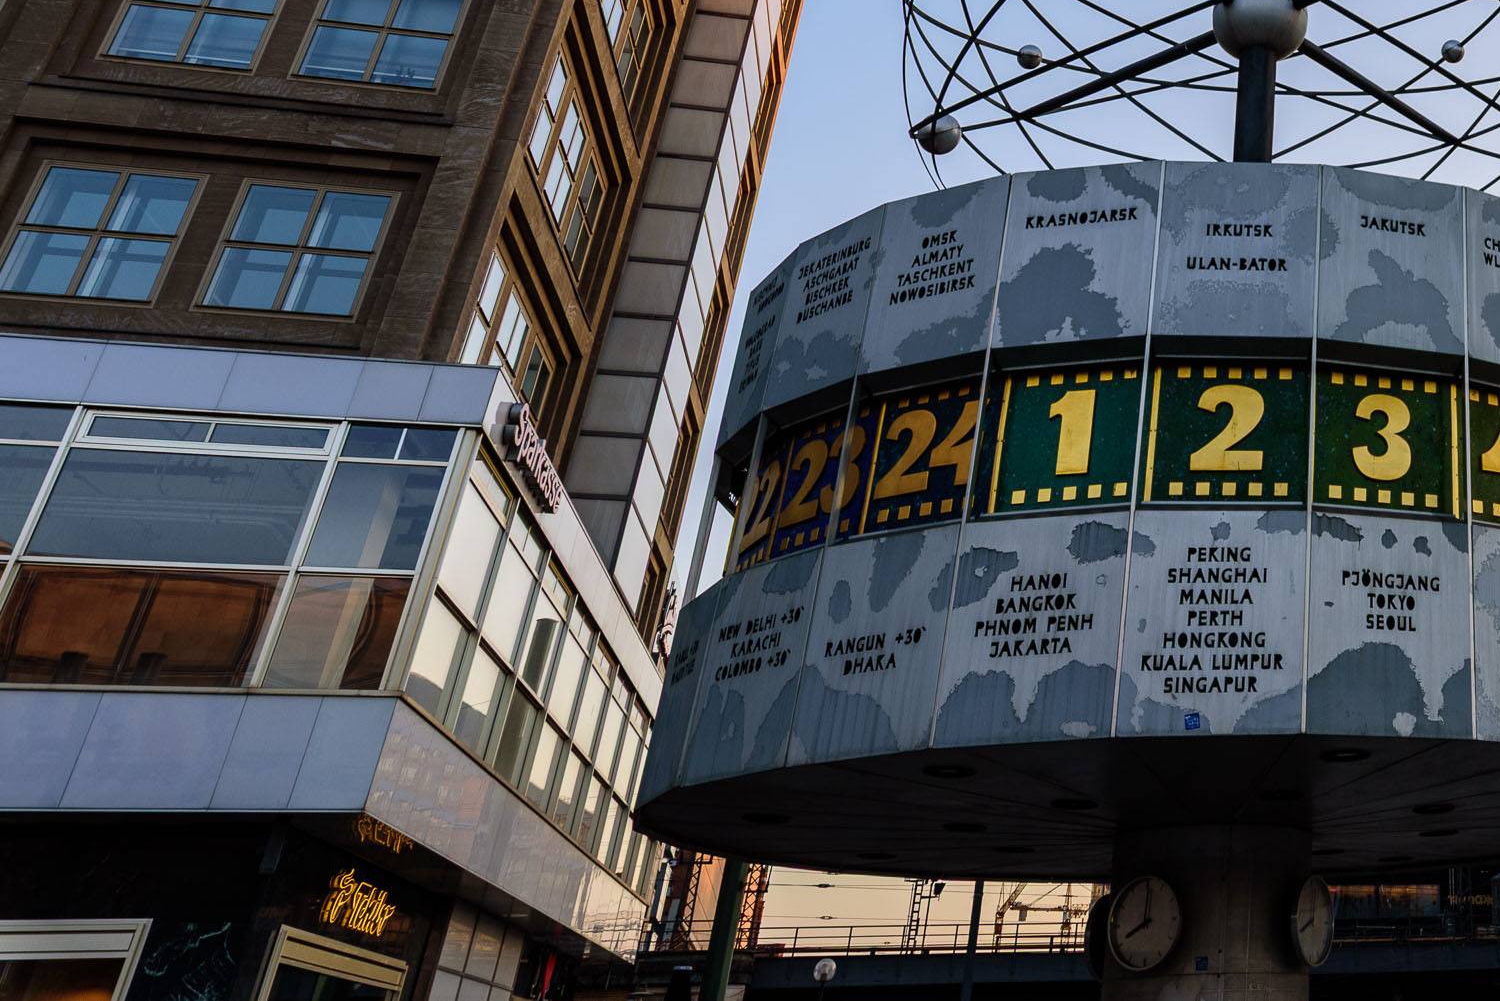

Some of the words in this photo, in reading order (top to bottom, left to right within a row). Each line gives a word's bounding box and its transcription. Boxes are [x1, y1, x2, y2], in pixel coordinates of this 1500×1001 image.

[1025, 206, 1138, 230] KRASNOJARSK
[1360, 215, 1426, 237] JAKUTSK
[921, 229, 958, 249] OMSK
[1205, 223, 1274, 238] IRKUTSK
[798, 237, 872, 280] JEKATERINBURG
[911, 244, 965, 268] ALMATY
[1186, 256, 1288, 272] ULAN-BATOR
[803, 257, 860, 292] ASCHGABAT
[897, 258, 975, 287] TASCHKENT
[804, 276, 850, 306] BISCHKEK
[889, 274, 976, 306] NOWOSIBIRSK
[796, 290, 854, 325] DUSCHANBE
[1048, 388, 1097, 476] 1
[1188, 384, 1265, 472] 2
[1351, 393, 1412, 481] 3
[514, 402, 565, 515] Sparkasse
[873, 398, 981, 500] 24
[778, 423, 867, 529] 23
[1186, 546, 1251, 563] PEKING
[1009, 572, 1068, 592] HANOI
[1167, 567, 1268, 584] SHANGHAI
[1341, 568, 1440, 593] PJÖNGJANG
[994, 593, 1077, 615] BANGKOK
[1178, 588, 1254, 605] MANILA
[1367, 593, 1416, 612] TOKYO
[718, 621, 743, 643] NEW
[745, 613, 777, 635] DELHI
[974, 616, 1039, 638] PHNOM
[1046, 613, 1094, 633] PENH
[1186, 610, 1244, 627] PERTH
[1365, 613, 1417, 633] SEOUL
[730, 631, 782, 659] KARACHI
[824, 632, 885, 659] RANGUN
[988, 636, 1073, 659] JAKARTA
[1162, 631, 1266, 649] HONGKONG
[714, 656, 762, 682] COLOMBO
[842, 652, 897, 676] DHAKA
[1140, 653, 1203, 672] KUALA
[1211, 653, 1284, 671] LUMPUR
[1162, 675, 1258, 694] SINGAPUR
